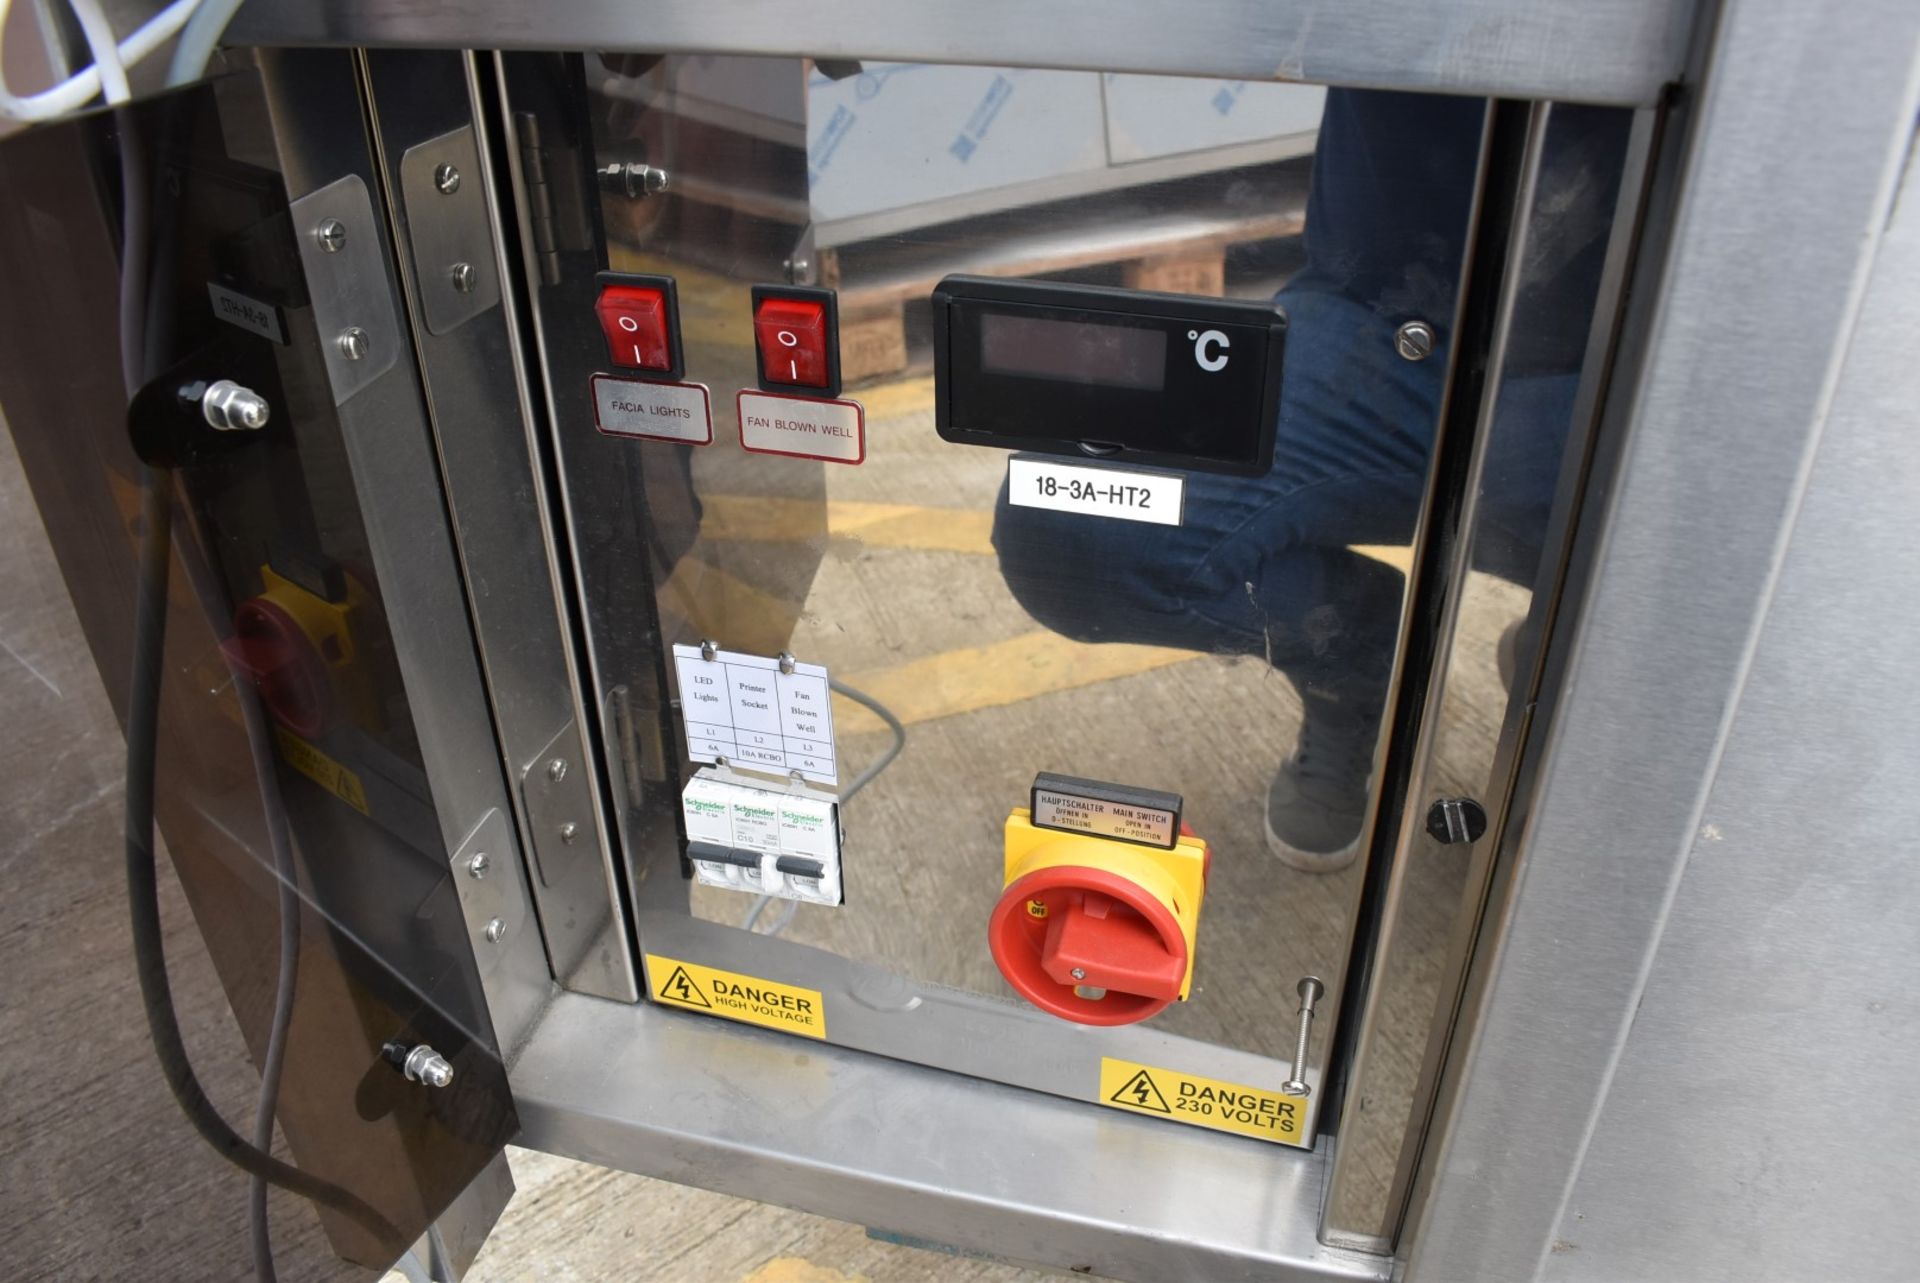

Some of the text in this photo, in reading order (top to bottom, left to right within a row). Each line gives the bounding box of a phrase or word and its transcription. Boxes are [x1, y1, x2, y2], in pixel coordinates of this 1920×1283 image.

[612, 401, 690, 419] FACIA LIGHTS
[747, 416, 853, 438] FAN BLOWN WELL
[1036, 475, 1151, 509] 18-3A-HT2
[694, 675, 713, 686] LED
[739, 682, 766, 694] Printer
[694, 692, 719, 703] Lights
[794, 691, 810, 701] Fan
[741, 699, 768, 710] Socket
[791, 707, 818, 718] Blown
[706, 728, 716, 736] L1
[796, 723, 816, 734] Well
[754, 736, 764, 744] L2
[708, 744, 720, 752] 6A
[741, 750, 782, 762] 10A RCBO
[804, 760, 815, 768] 6A
[685, 798, 725, 811] Schneider
[1041, 795, 1105, 813] HAUPTSCHALTER
[734, 804, 776, 817] Schneider
[1113, 807, 1167, 824] MAIN SWITCH
[782, 811, 824, 824] Schneider
[1125, 819, 1151, 830] OPEN IN
[737, 834, 754, 843] C10
[1031, 906, 1045, 916] OFF
[713, 979, 813, 1014] DANGER
[715, 996, 814, 1026] HIGH VOLTAGE
[1179, 1081, 1295, 1119] DANGER
[1175, 1097, 1295, 1133] 230 VOLTS
